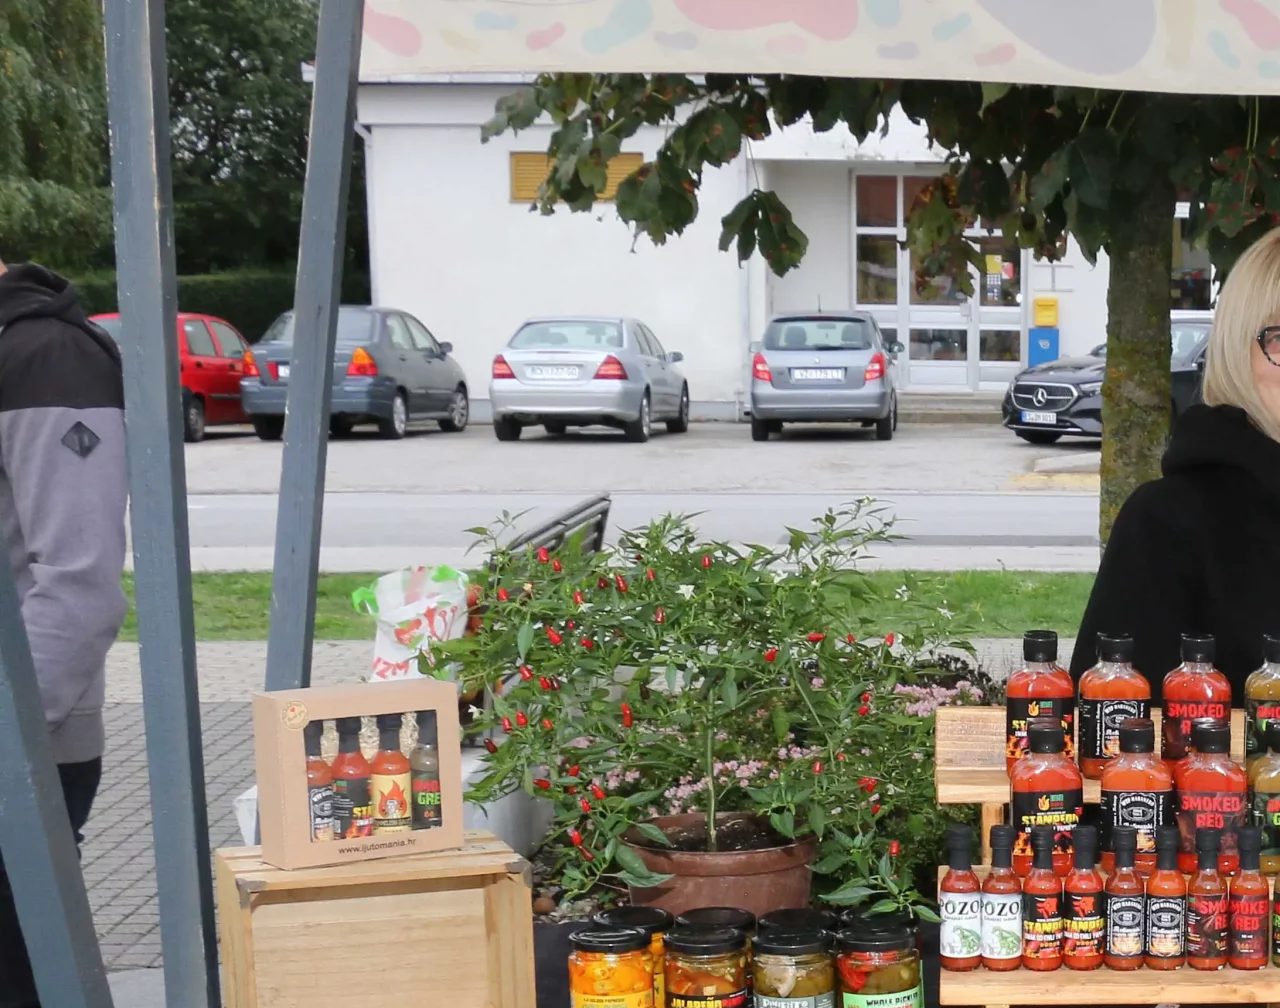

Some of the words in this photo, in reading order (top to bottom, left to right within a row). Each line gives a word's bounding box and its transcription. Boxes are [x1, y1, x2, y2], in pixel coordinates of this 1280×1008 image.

[1168, 703, 1225, 718] SMOKED
[1182, 796, 1241, 812] SMOKED
[1196, 813, 1224, 828] RED
[1236, 916, 1260, 930] RED
[763, 998, 808, 1008] PIMIENTO
[866, 998, 892, 1007] WHOLE
